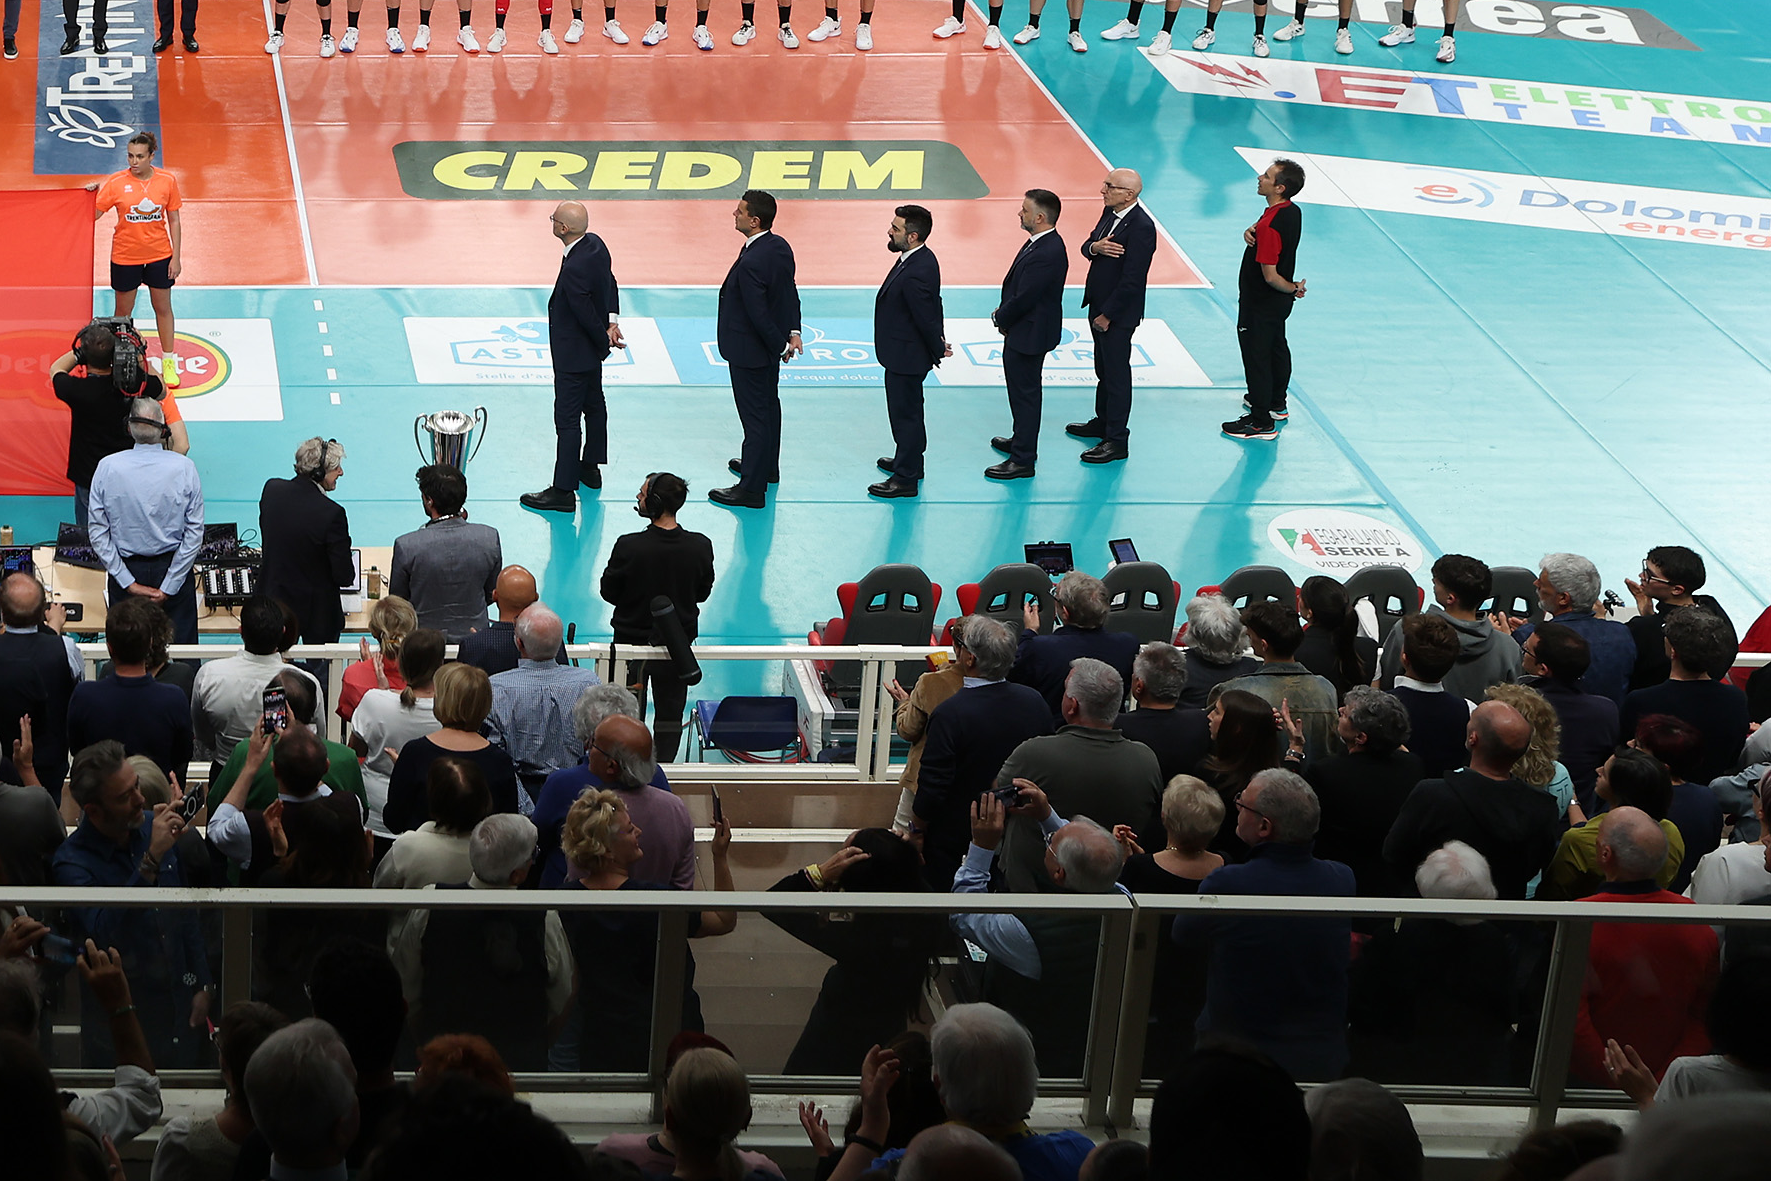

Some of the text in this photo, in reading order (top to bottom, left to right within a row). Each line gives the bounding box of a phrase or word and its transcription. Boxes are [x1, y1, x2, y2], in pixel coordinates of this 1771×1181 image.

[433, 150, 925, 191] CREDEM
[1324, 546, 1412, 557] SERIE A
[1315, 560, 1360, 569] VIDEO
